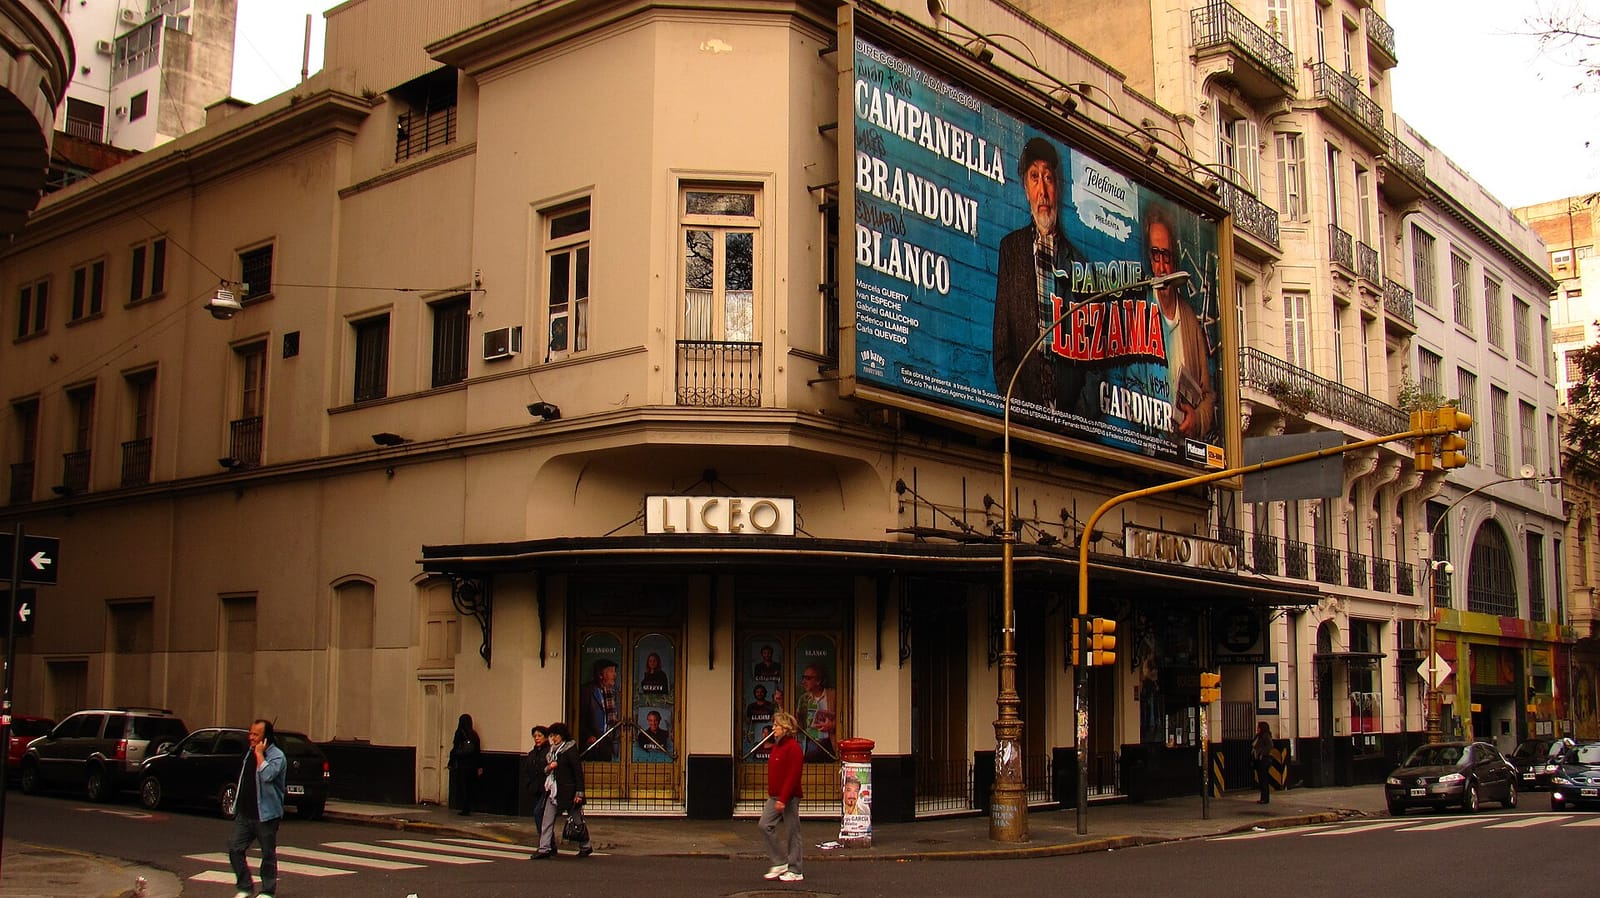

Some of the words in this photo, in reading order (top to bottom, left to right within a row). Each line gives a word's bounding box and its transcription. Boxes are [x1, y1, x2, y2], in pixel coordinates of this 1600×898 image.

[914, 67, 920, 80] Y
[855, 79, 1006, 185] CAMPANELLA
[856, 151, 978, 237] BRANDONI
[1095, 214, 1120, 231] PRESENTA
[856, 223, 950, 295] BLANCO
[856, 279, 880, 294] Marcela
[881, 288, 909, 303] GUERTY
[1071, 260, 1143, 297] PARQUE
[856, 301, 878, 315] Gabriel
[879, 308, 919, 327] GALLICCHIO
[870, 294, 902, 312] ESPECHE
[856, 311, 884, 327] Federico
[1050, 292, 1165, 361] LEZAMA
[856, 323, 873, 335] Carla
[874, 328, 907, 345] QUEVEDO
[912, 371, 924, 380] obra
[923, 381, 932, 390] The
[1100, 380, 1174, 433] GARDNER
[663, 498, 781, 533] LICEO
[1258, 666, 1277, 709] E
